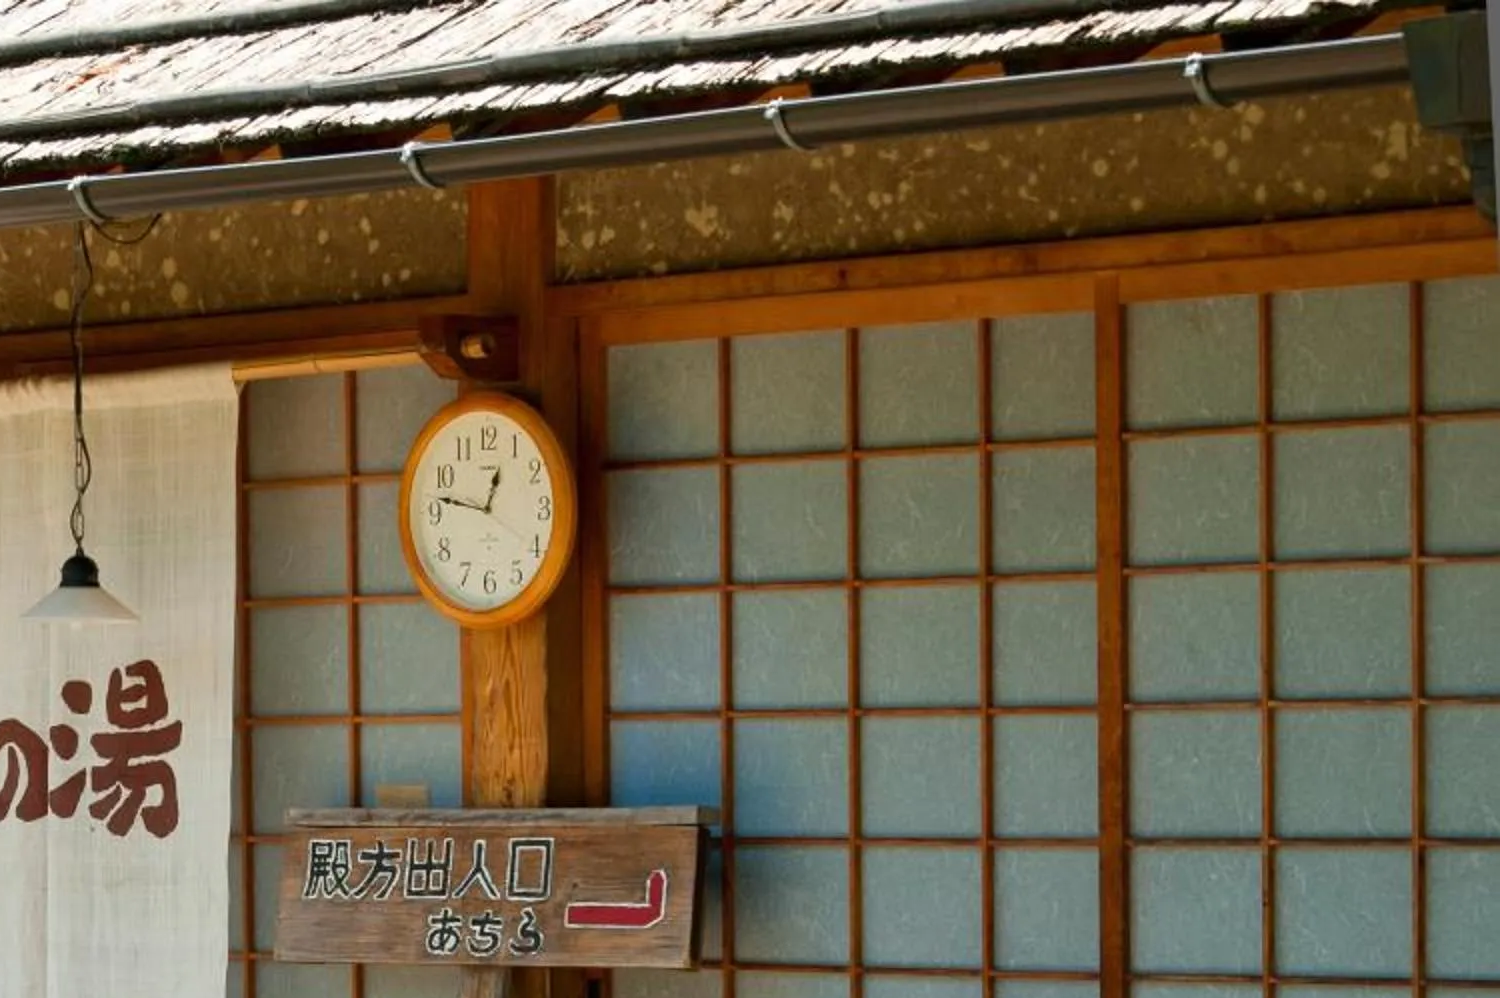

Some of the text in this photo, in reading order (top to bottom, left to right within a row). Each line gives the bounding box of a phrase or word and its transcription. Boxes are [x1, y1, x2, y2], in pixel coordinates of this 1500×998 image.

[456, 435, 471, 461] 11
[481, 424, 498, 451] 12
[437, 463, 455, 489] 10
[528, 459, 542, 484] 2
[428, 501, 442, 526] 9
[537, 495, 551, 521] 3
[436, 537, 451, 562] 8
[528, 533, 540, 559] 4
[457, 562, 472, 589] 7
[483, 571, 498, 595] 6
[509, 560, 524, 586] 5
[425, 906, 545, 958] あちら
